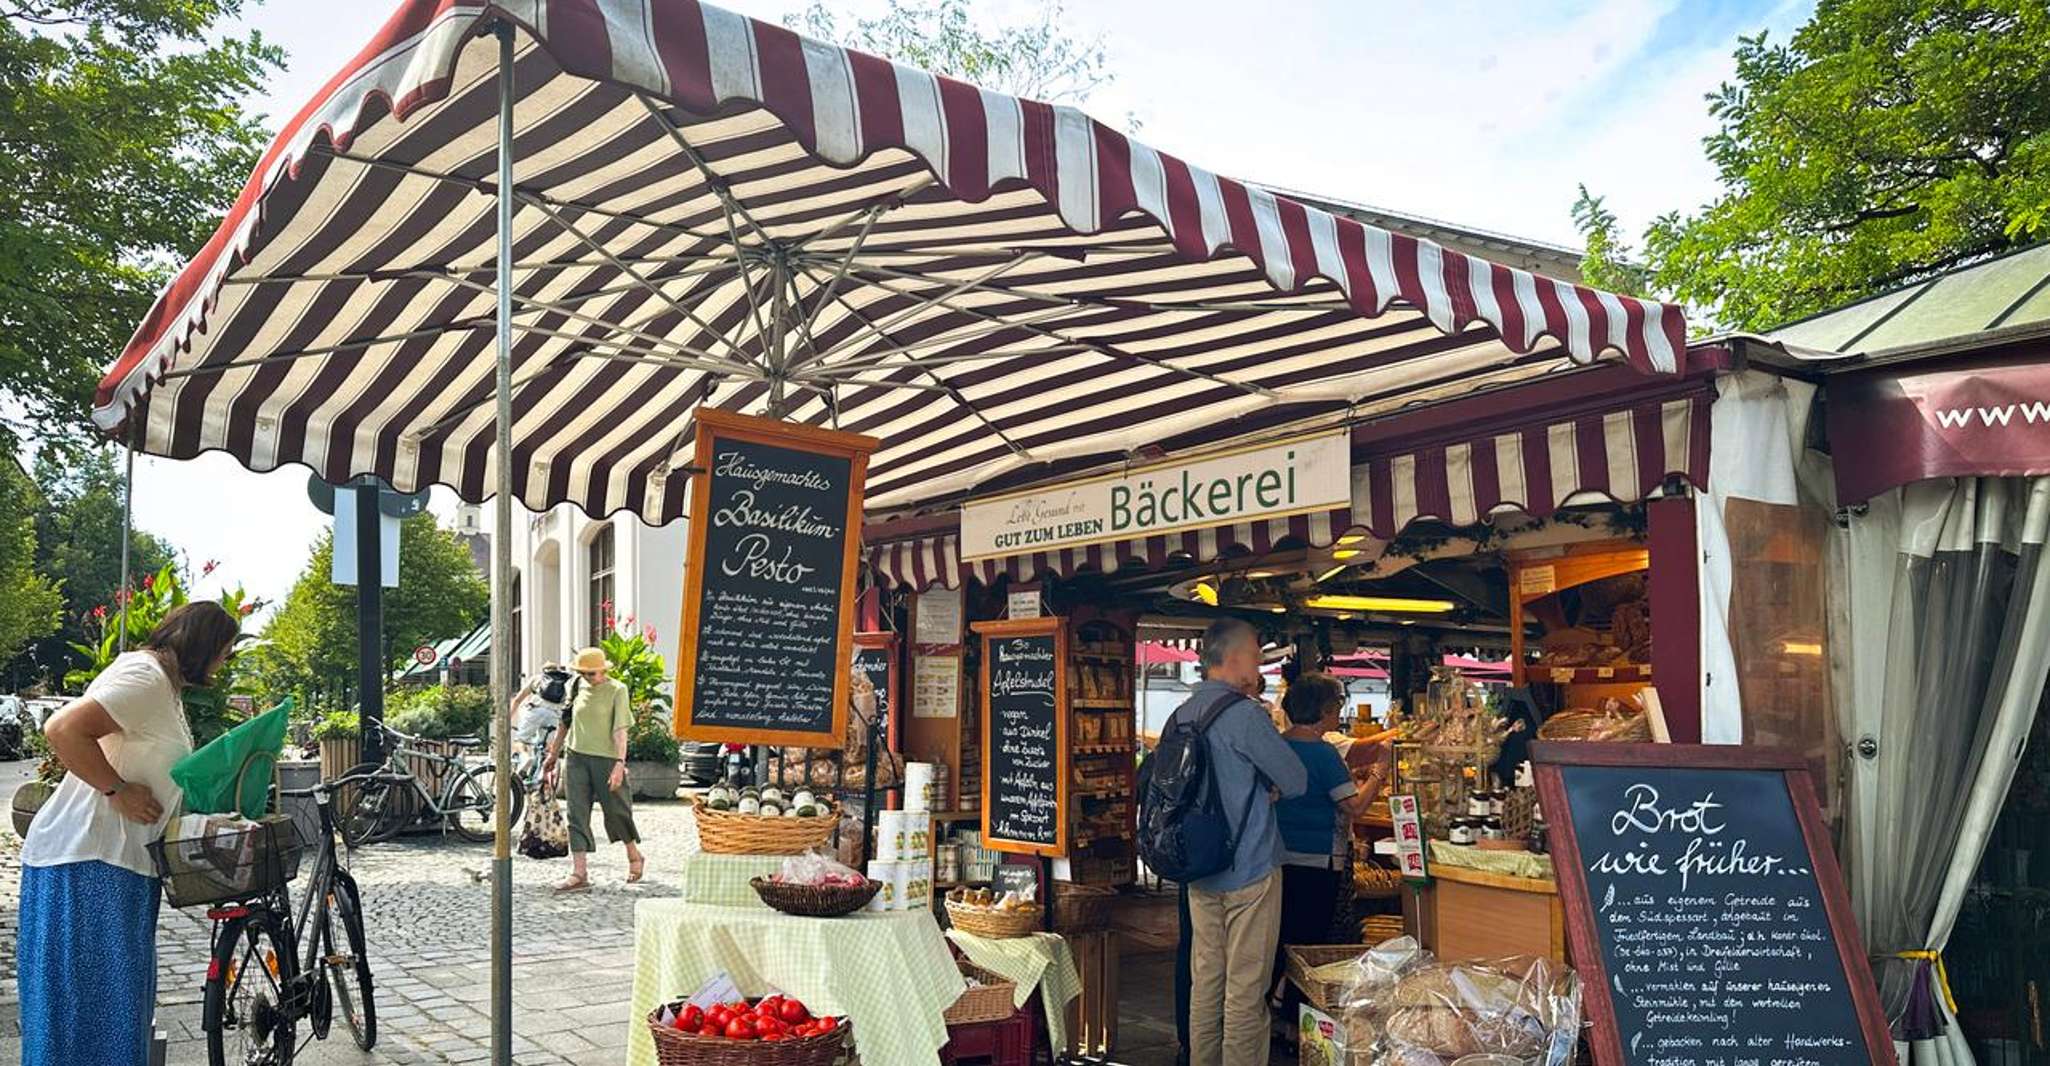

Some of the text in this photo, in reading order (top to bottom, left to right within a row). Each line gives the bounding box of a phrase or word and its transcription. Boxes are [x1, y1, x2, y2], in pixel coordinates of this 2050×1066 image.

[715, 450, 830, 491] Hausgemachtes
[1111, 450, 1296, 531] Bäckerei
[714, 490, 840, 538] Basilikum-
[995, 518, 1103, 549] GUT ZUM LEBEN
[722, 533, 816, 583] Pesto
[420, 651, 433, 660] 30
[993, 669, 1055, 696] Apfelstrudel
[1001, 710, 1029, 725] vegan
[1020, 721, 1052, 740] Dinkel
[1611, 783, 1726, 835] Brot
[1589, 837, 1809, 892] wie früher...
[1667, 896, 1717, 913] eigenem
[1724, 892, 1776, 914] Getreide
[1609, 911, 1632, 924] dem
[1624, 960, 1651, 973] ohne
[1656, 960, 1680, 972] Mist
[1714, 959, 1742, 979] Gülle
[1699, 997, 1717, 1008] mit
[1711, 1034, 1740, 1048] nach
[1746, 1034, 1775, 1047] alter
[1705, 1056, 1726, 1066] mit
